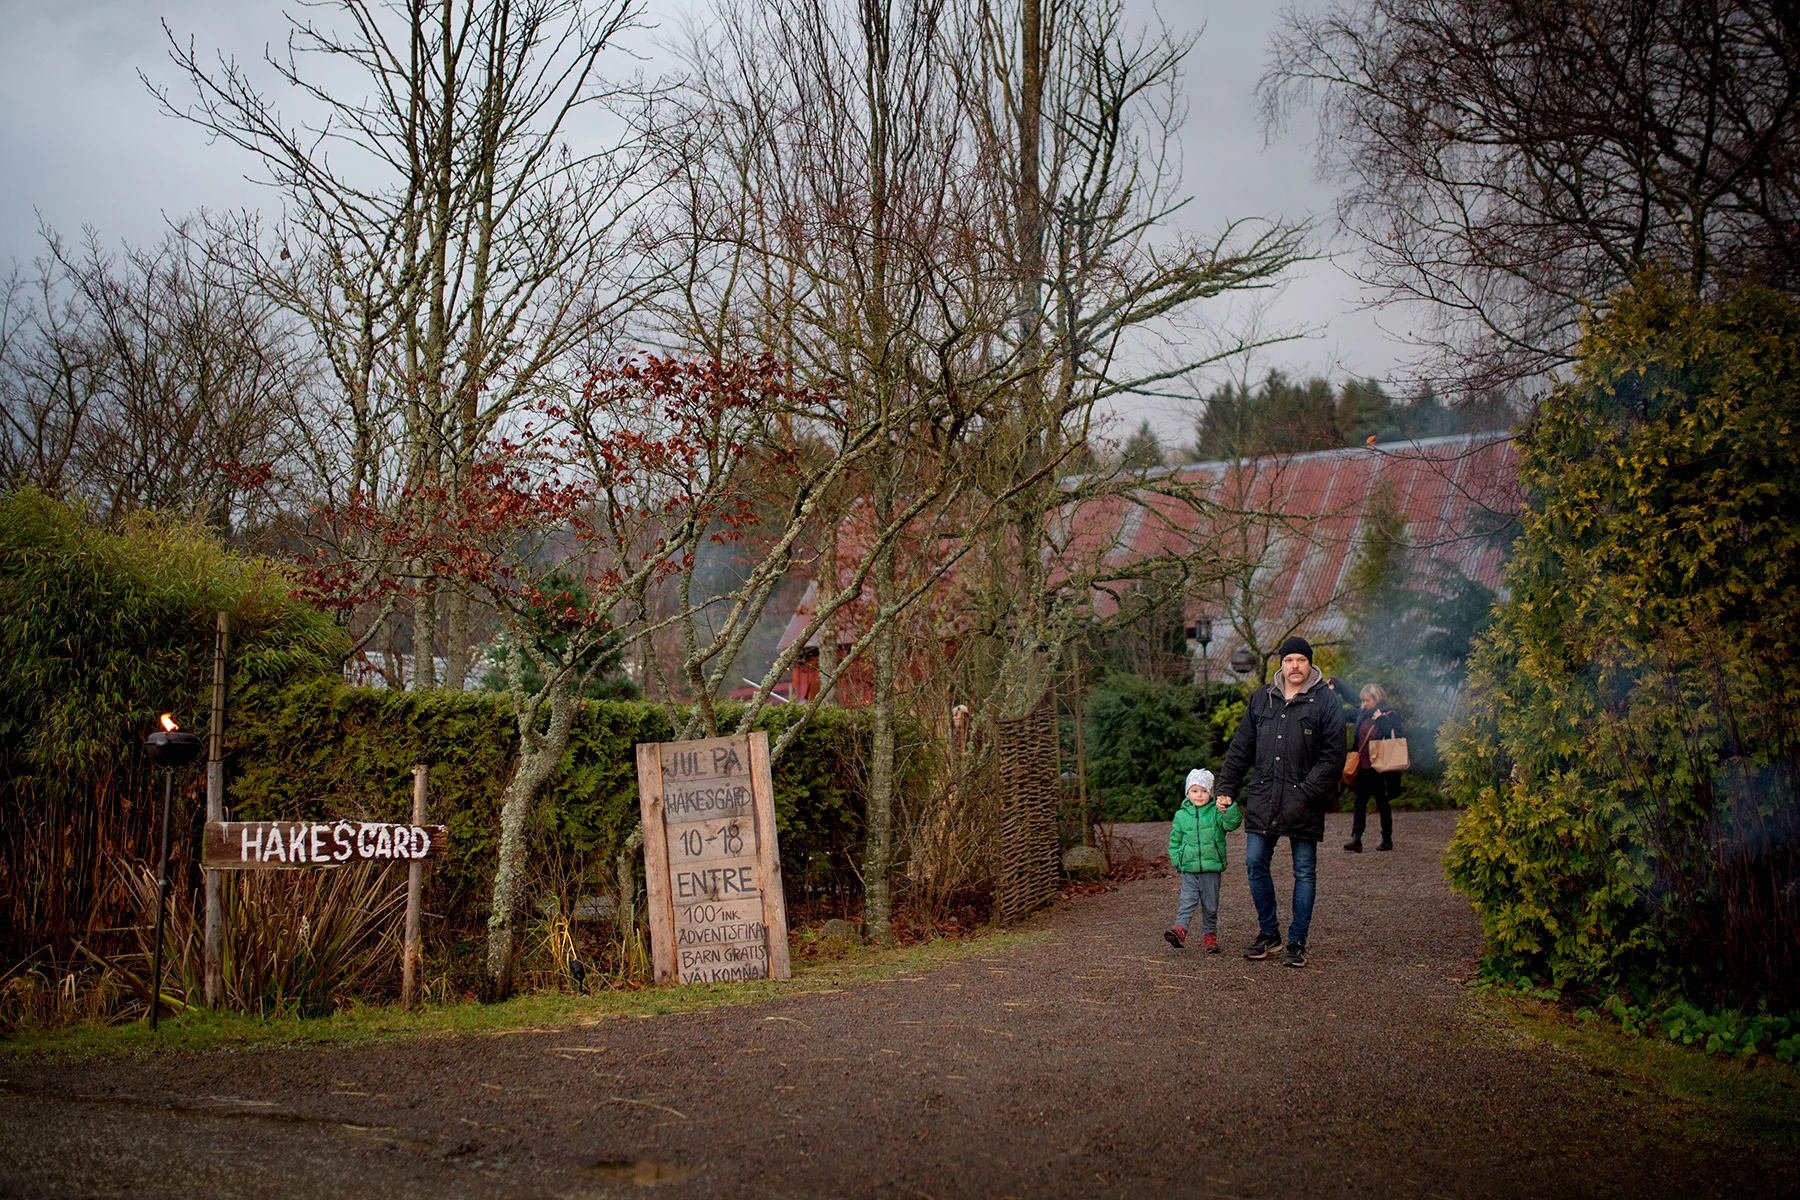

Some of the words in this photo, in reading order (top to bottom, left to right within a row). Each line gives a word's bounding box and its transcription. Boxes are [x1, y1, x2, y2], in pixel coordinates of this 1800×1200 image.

[664, 751, 706, 777] JUL
[710, 742, 743, 773] PÅ
[680, 824, 743, 856] 10-18
[677, 866, 757, 897] ENTRE
[682, 949, 720, 969] BARN
[724, 945, 765, 961] GRATIS
